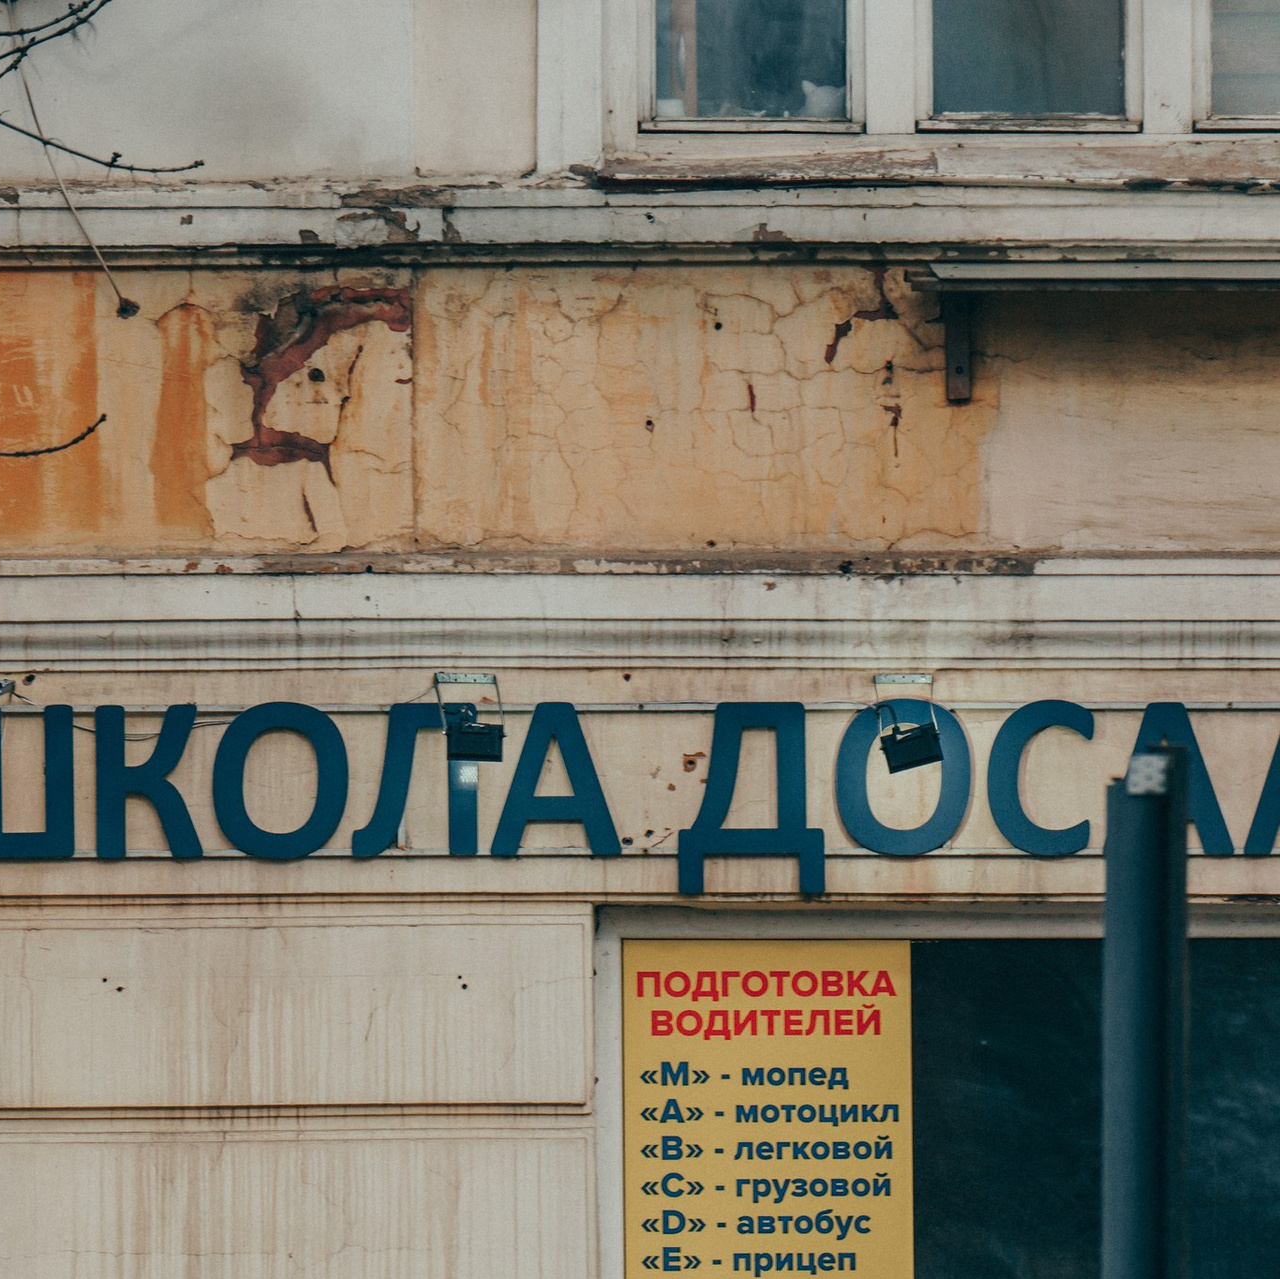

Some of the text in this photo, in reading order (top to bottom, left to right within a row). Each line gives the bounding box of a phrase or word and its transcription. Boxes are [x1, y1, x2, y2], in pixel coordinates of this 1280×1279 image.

[678, 698, 1280, 895] ДОСА
[637, 971, 896, 1002] ПОДГОТОВКА
[651, 1004, 881, 1040] ВОДИТЕЛЕЙ
[741, 1067, 849, 1090] мопед
[735, 1104, 899, 1127] мотоцикл
[734, 1135, 893, 1160] легковой
[736, 1173, 891, 1203] грузовой
[641, 1210, 706, 1234] «D»
[736, 1209, 871, 1240] автобус
[733, 1253, 856, 1277] прицеп
